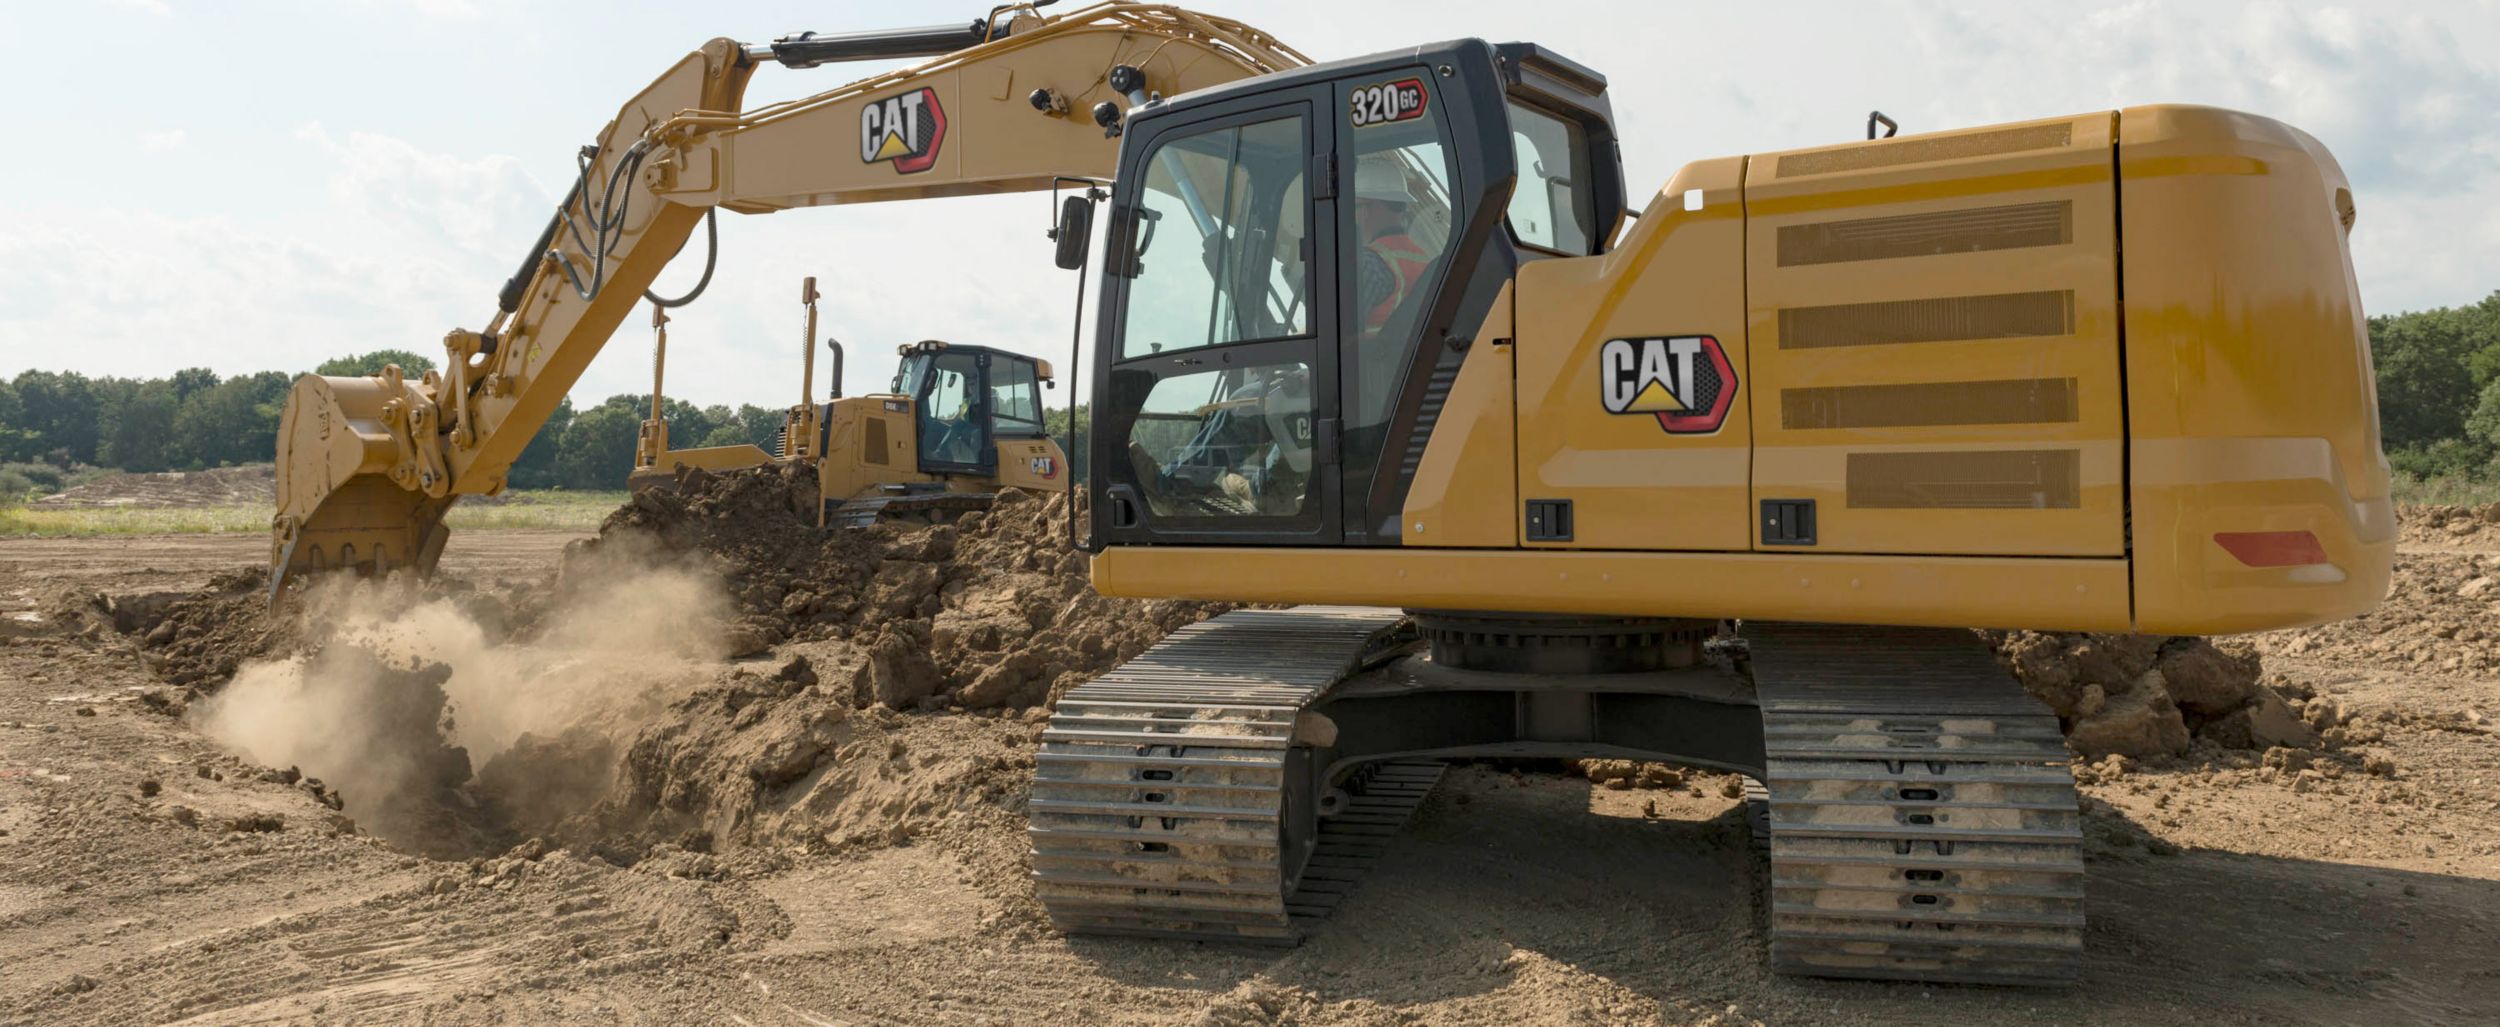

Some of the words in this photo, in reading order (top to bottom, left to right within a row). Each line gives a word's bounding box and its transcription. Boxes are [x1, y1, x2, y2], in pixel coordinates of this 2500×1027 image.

[861, 89, 923, 162] CAT
[1351, 83, 1399, 126] 320
[1601, 337, 1702, 413] CAT
[1031, 457, 1051, 475] CAT
